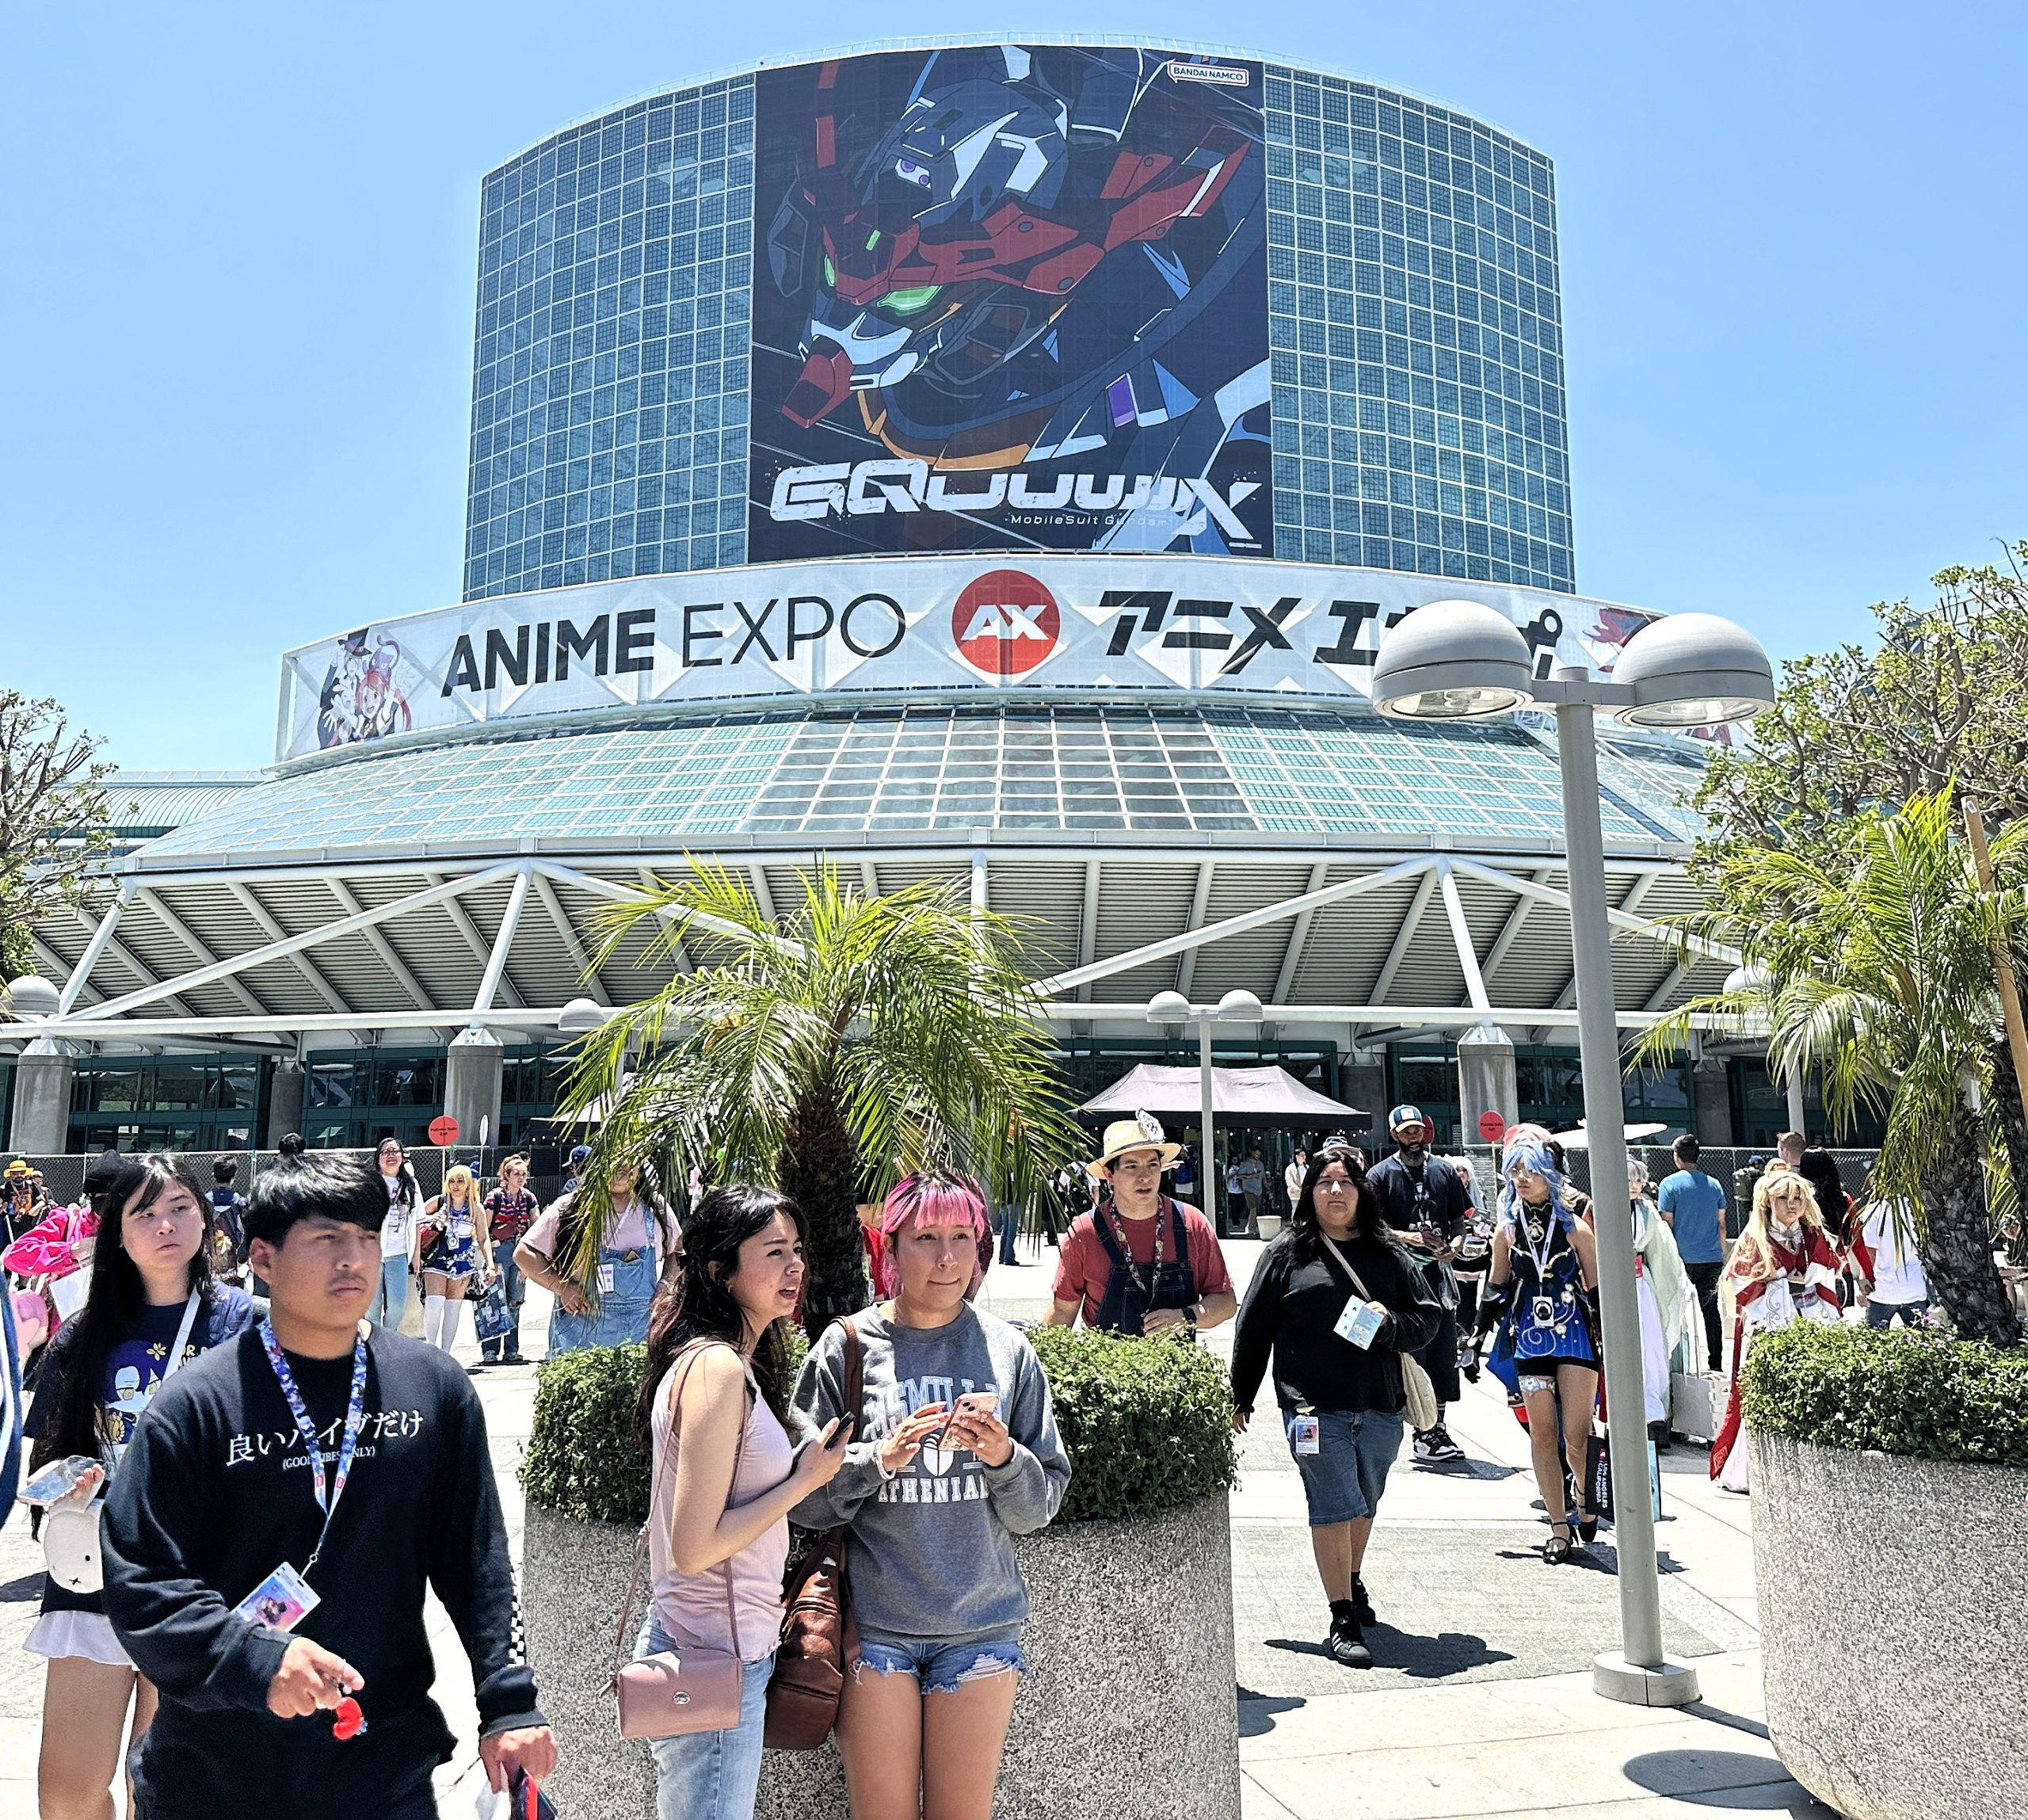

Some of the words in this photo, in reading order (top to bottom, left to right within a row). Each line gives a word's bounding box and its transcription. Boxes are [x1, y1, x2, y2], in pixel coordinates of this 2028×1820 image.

[1173, 67, 1208, 77] BANDAI
[1209, 71, 1243, 81] NAMCO
[1104, 515, 1168, 527] Gundam
[960, 603, 1049, 641] AX
[440, 608, 656, 697] ANIME
[682, 593, 907, 668] EXPO
[353, 1445, 375, 1458] NLY)
